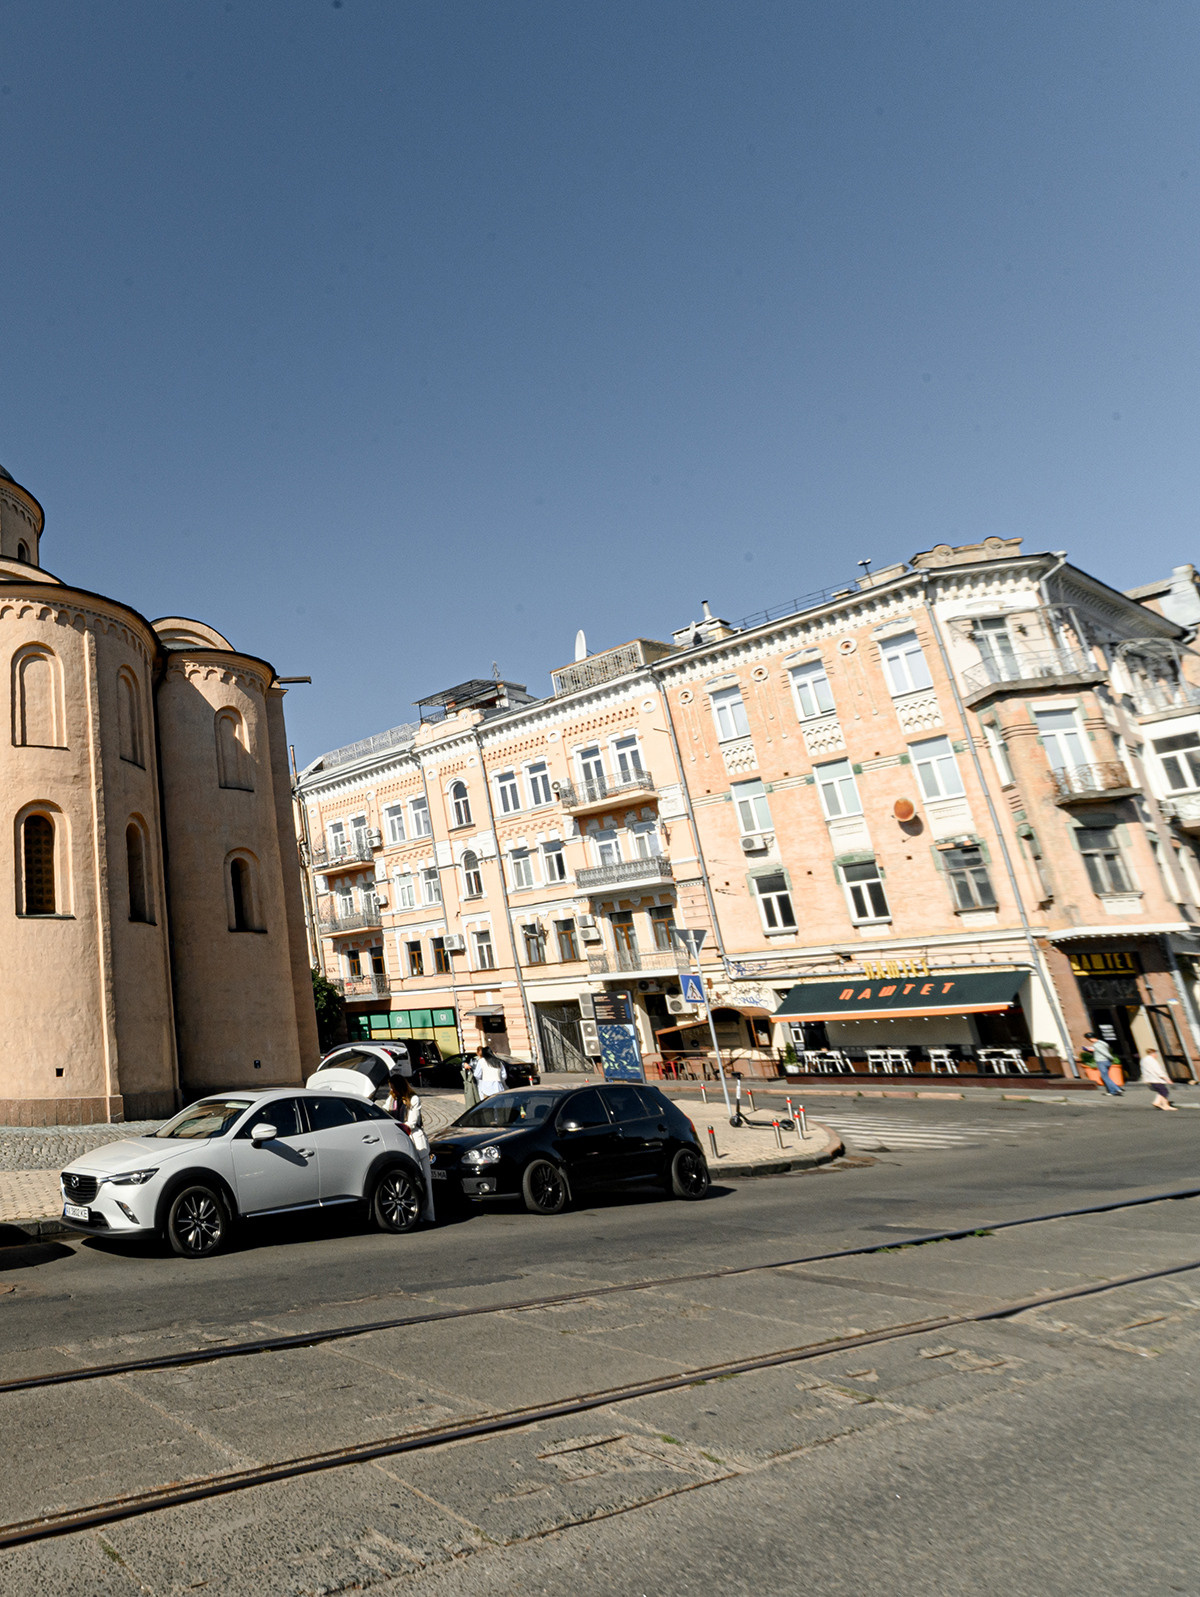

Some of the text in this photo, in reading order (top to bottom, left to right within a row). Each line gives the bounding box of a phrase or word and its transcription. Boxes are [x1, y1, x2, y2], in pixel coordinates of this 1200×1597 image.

[863, 957, 929, 980] ПАШТЕТ
[1069, 953, 1134, 970] ПАШТЕТ
[839, 982, 955, 1000] ПАШТЕТ
